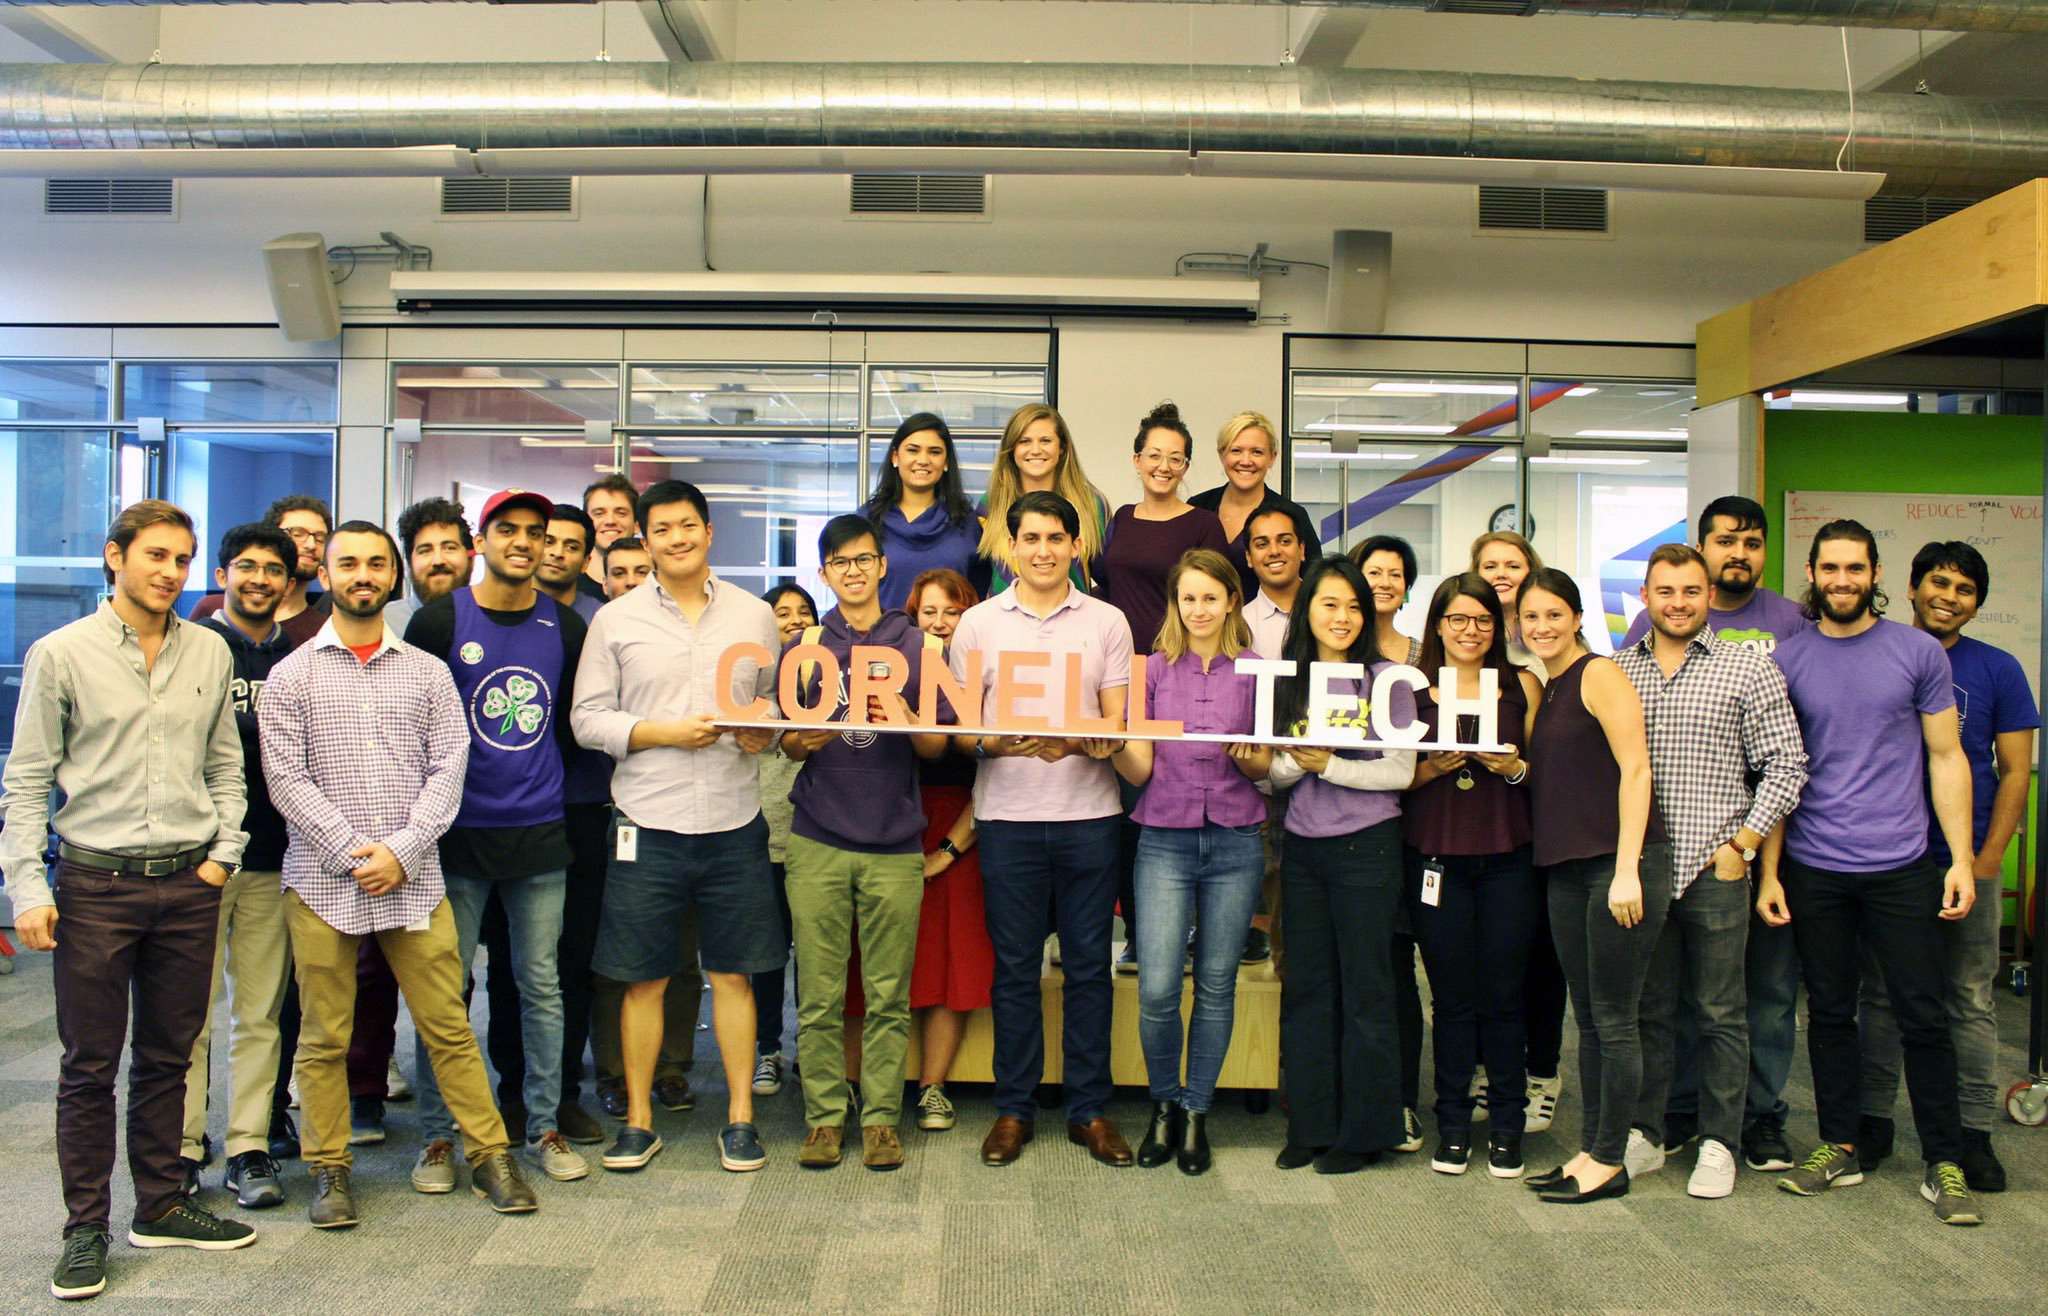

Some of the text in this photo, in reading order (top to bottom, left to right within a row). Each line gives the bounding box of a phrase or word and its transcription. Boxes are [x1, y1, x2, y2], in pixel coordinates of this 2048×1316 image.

[1906, 503, 1967, 519] REDUCE
[714, 641, 1184, 737] CORNELL
[1234, 658, 1500, 746] TECH
